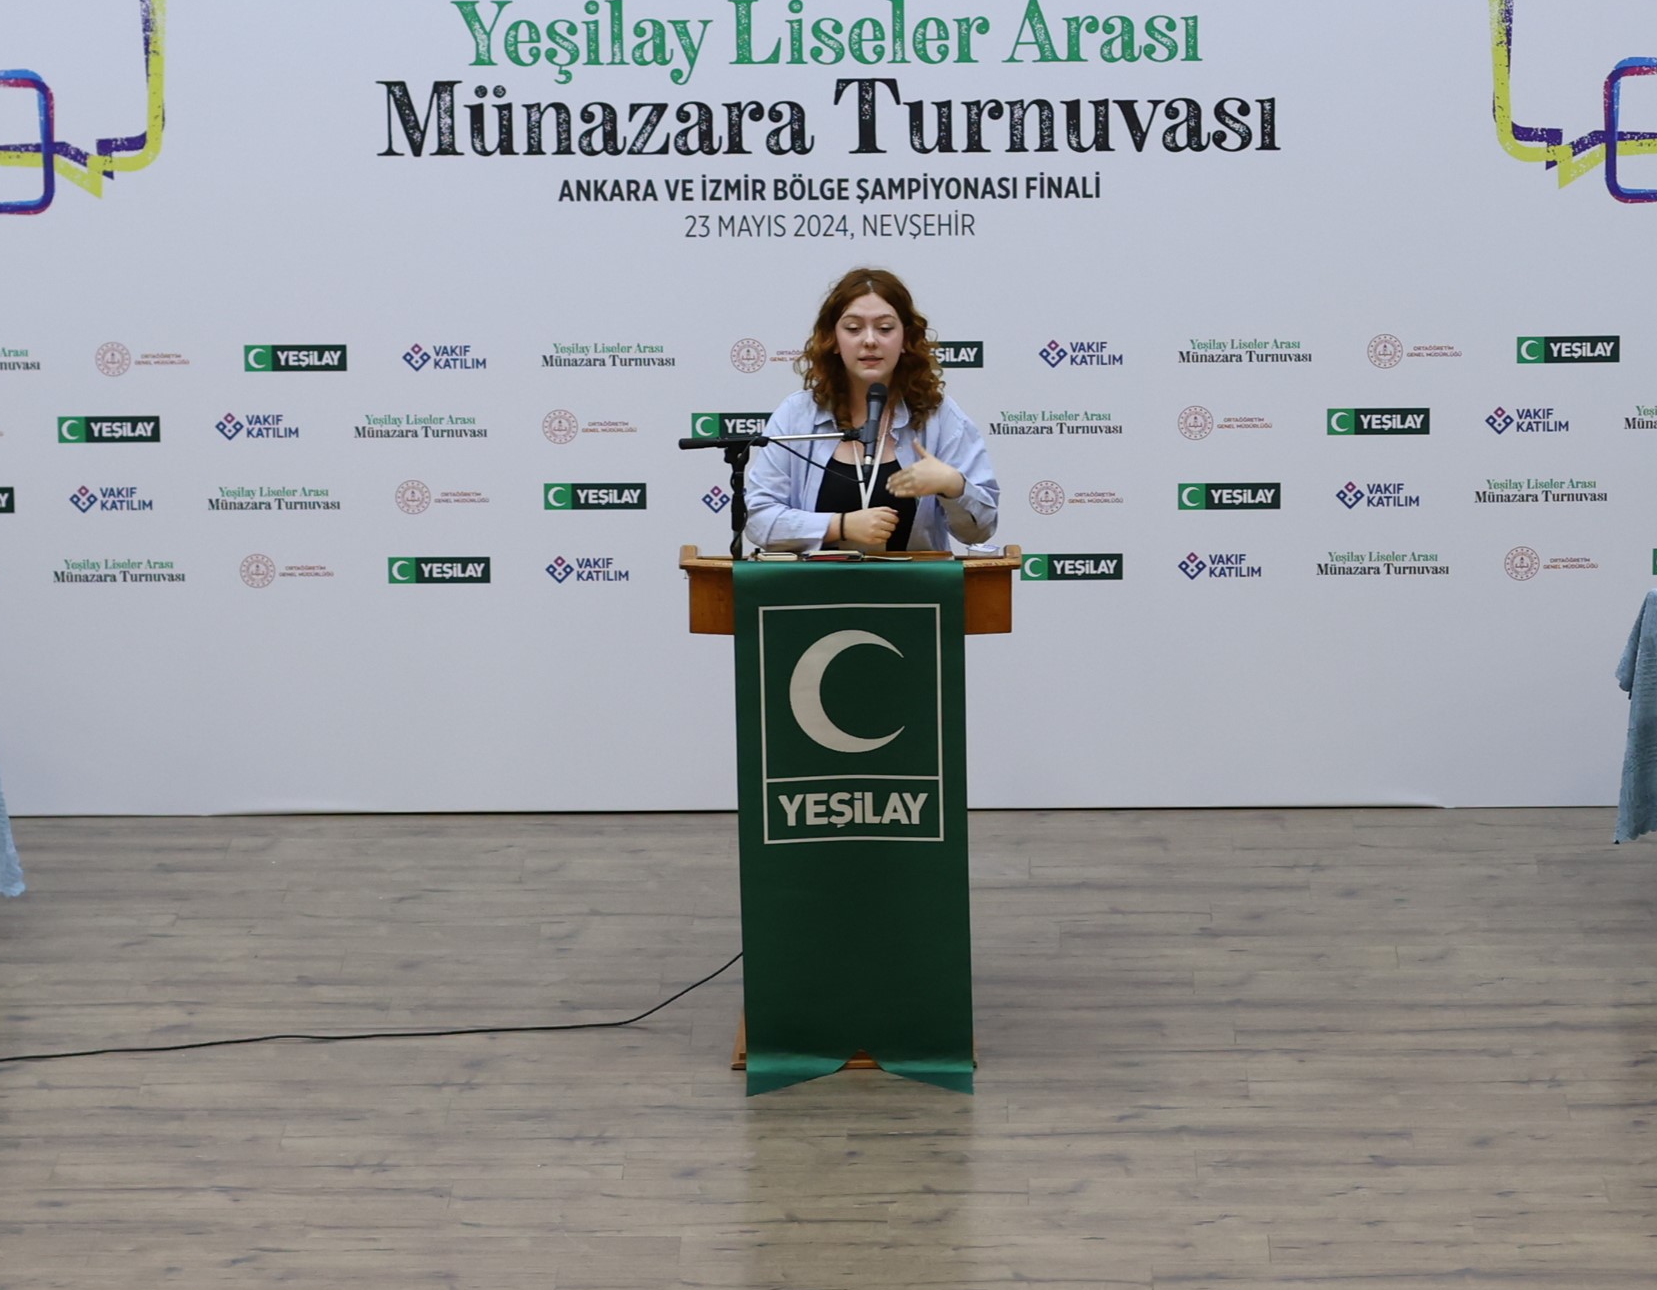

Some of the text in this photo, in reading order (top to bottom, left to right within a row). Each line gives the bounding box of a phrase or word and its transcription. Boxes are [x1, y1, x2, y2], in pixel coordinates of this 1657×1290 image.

[376, 76, 1282, 157] Münazara Turnuvası
[558, 172, 1101, 204] ANKARA VE İZMİR BÖLGE ŞAMPİYONASI FİNALİ
[685, 210, 976, 241] 23 MAYIS 2024, NEVŞEHİR
[433, 345, 470, 356] VAKIF
[1070, 342, 1107, 352] VAKIF
[542, 354, 675, 367] Münazara Turnuvası
[930, 347, 978, 364] ŞİLAY
[1070, 354, 1123, 365] KATILIM
[1179, 350, 1312, 363] Münazara Turnuvası
[434, 357, 487, 369] KATILIM
[1516, 408, 1554, 419] VAKIF
[246, 415, 283, 425] VAKIF
[724, 418, 766, 435] YEŞİ
[990, 422, 1123, 435] Münazara Turnuvası
[1516, 421, 1569, 432] KATILIM
[246, 427, 299, 438] KATILIM
[100, 487, 137, 498] VAKIF
[1367, 483, 1404, 494] VAKIF
[1367, 495, 1420, 507] KATILIM
[1475, 490, 1608, 503] Münazara Turnuvası
[100, 499, 153, 511] KATILIM
[576, 558, 613, 569] VAKIF
[1209, 554, 1246, 565] VAKIF
[1209, 566, 1262, 577] KATILIM
[1317, 562, 1450, 575] Münazara Turnuvası
[576, 570, 629, 581] KATILIM
